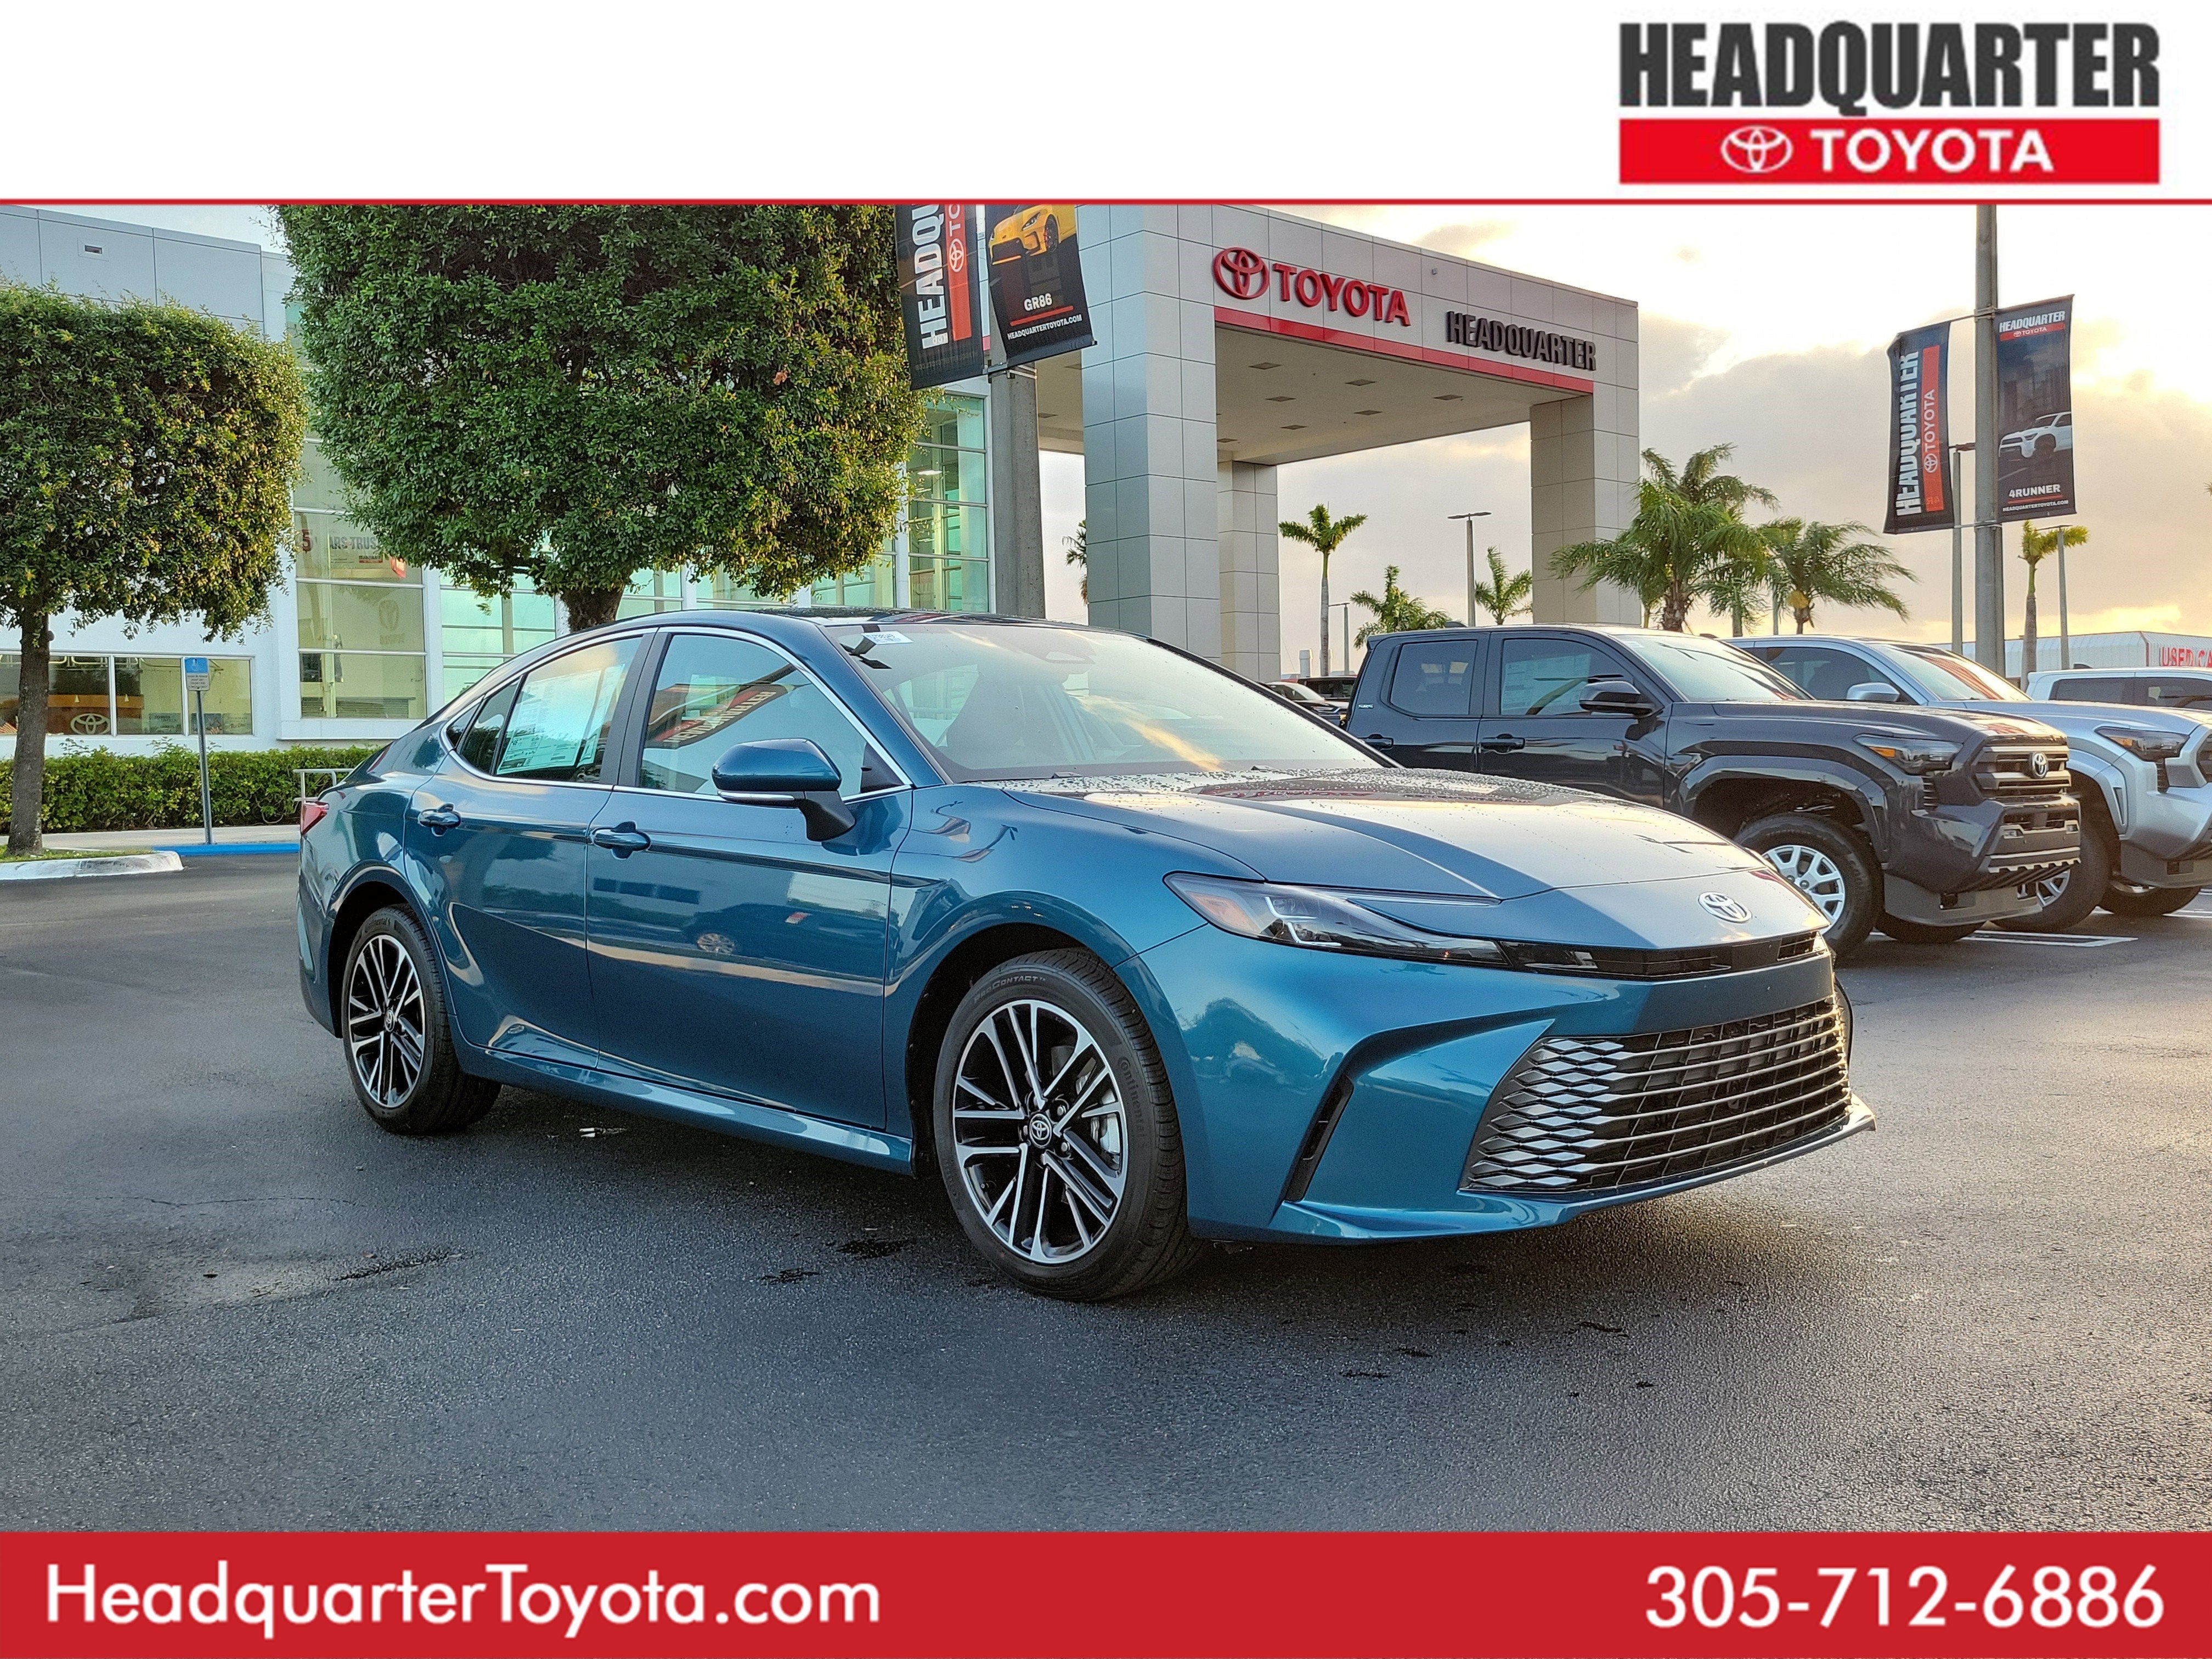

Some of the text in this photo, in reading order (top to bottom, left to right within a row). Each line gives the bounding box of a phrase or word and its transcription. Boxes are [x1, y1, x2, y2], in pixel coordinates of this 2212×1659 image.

[1024, 293, 1052, 311] GR86
[1273, 263, 1410, 326] TOYOTA
[1007, 314, 1082, 340] HEADQUARTERTOYOTA.COM
[1999, 311, 2065, 333] HEADQUARTER
[2022, 326, 2047, 335] TOYOTA
[1446, 311, 1596, 371] HEADQUARTER
[1924, 389, 1936, 452] TOYOTA
[1895, 351, 1921, 516] HEADQUARTER
[2009, 484, 2061, 498] 4RUNNER
[2003, 500, 2068, 512] HEADQUARTERTOYOTA.COM
[349, 537, 378, 549] TRUS
[2161, 647, 2194, 667] USED
